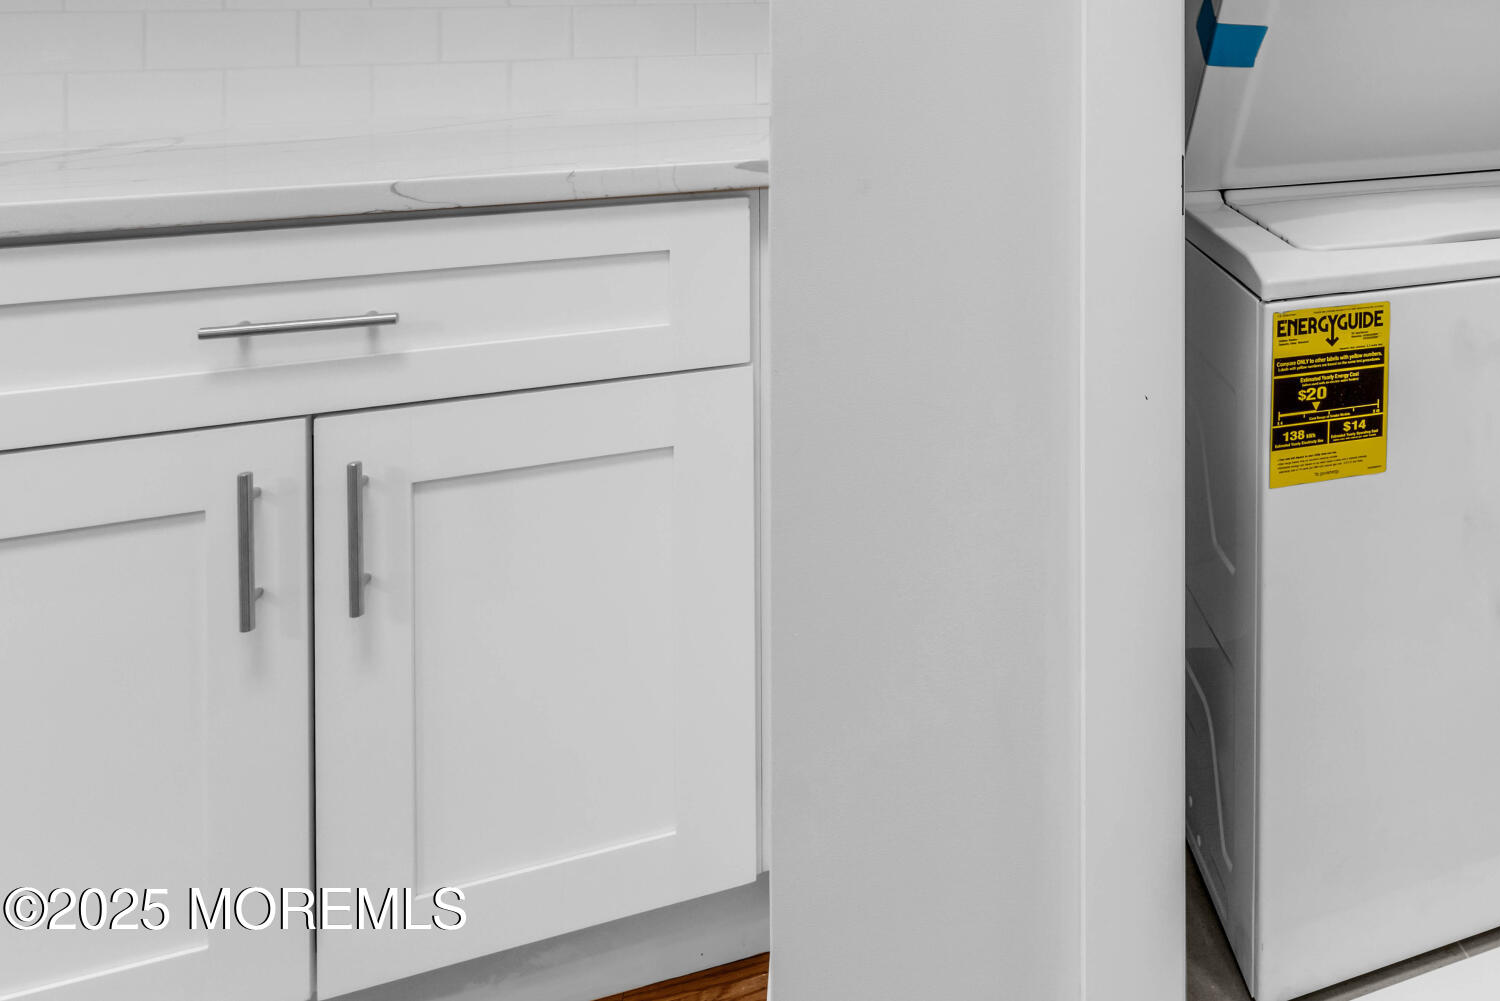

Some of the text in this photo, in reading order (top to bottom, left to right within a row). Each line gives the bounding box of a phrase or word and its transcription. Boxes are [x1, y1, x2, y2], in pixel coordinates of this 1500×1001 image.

[1277, 310, 1384, 338] ENERGYGUIDE
[1297, 386, 1328, 402] $20
[1342, 419, 1366, 432] $14
[1282, 430, 1305, 442] 138
